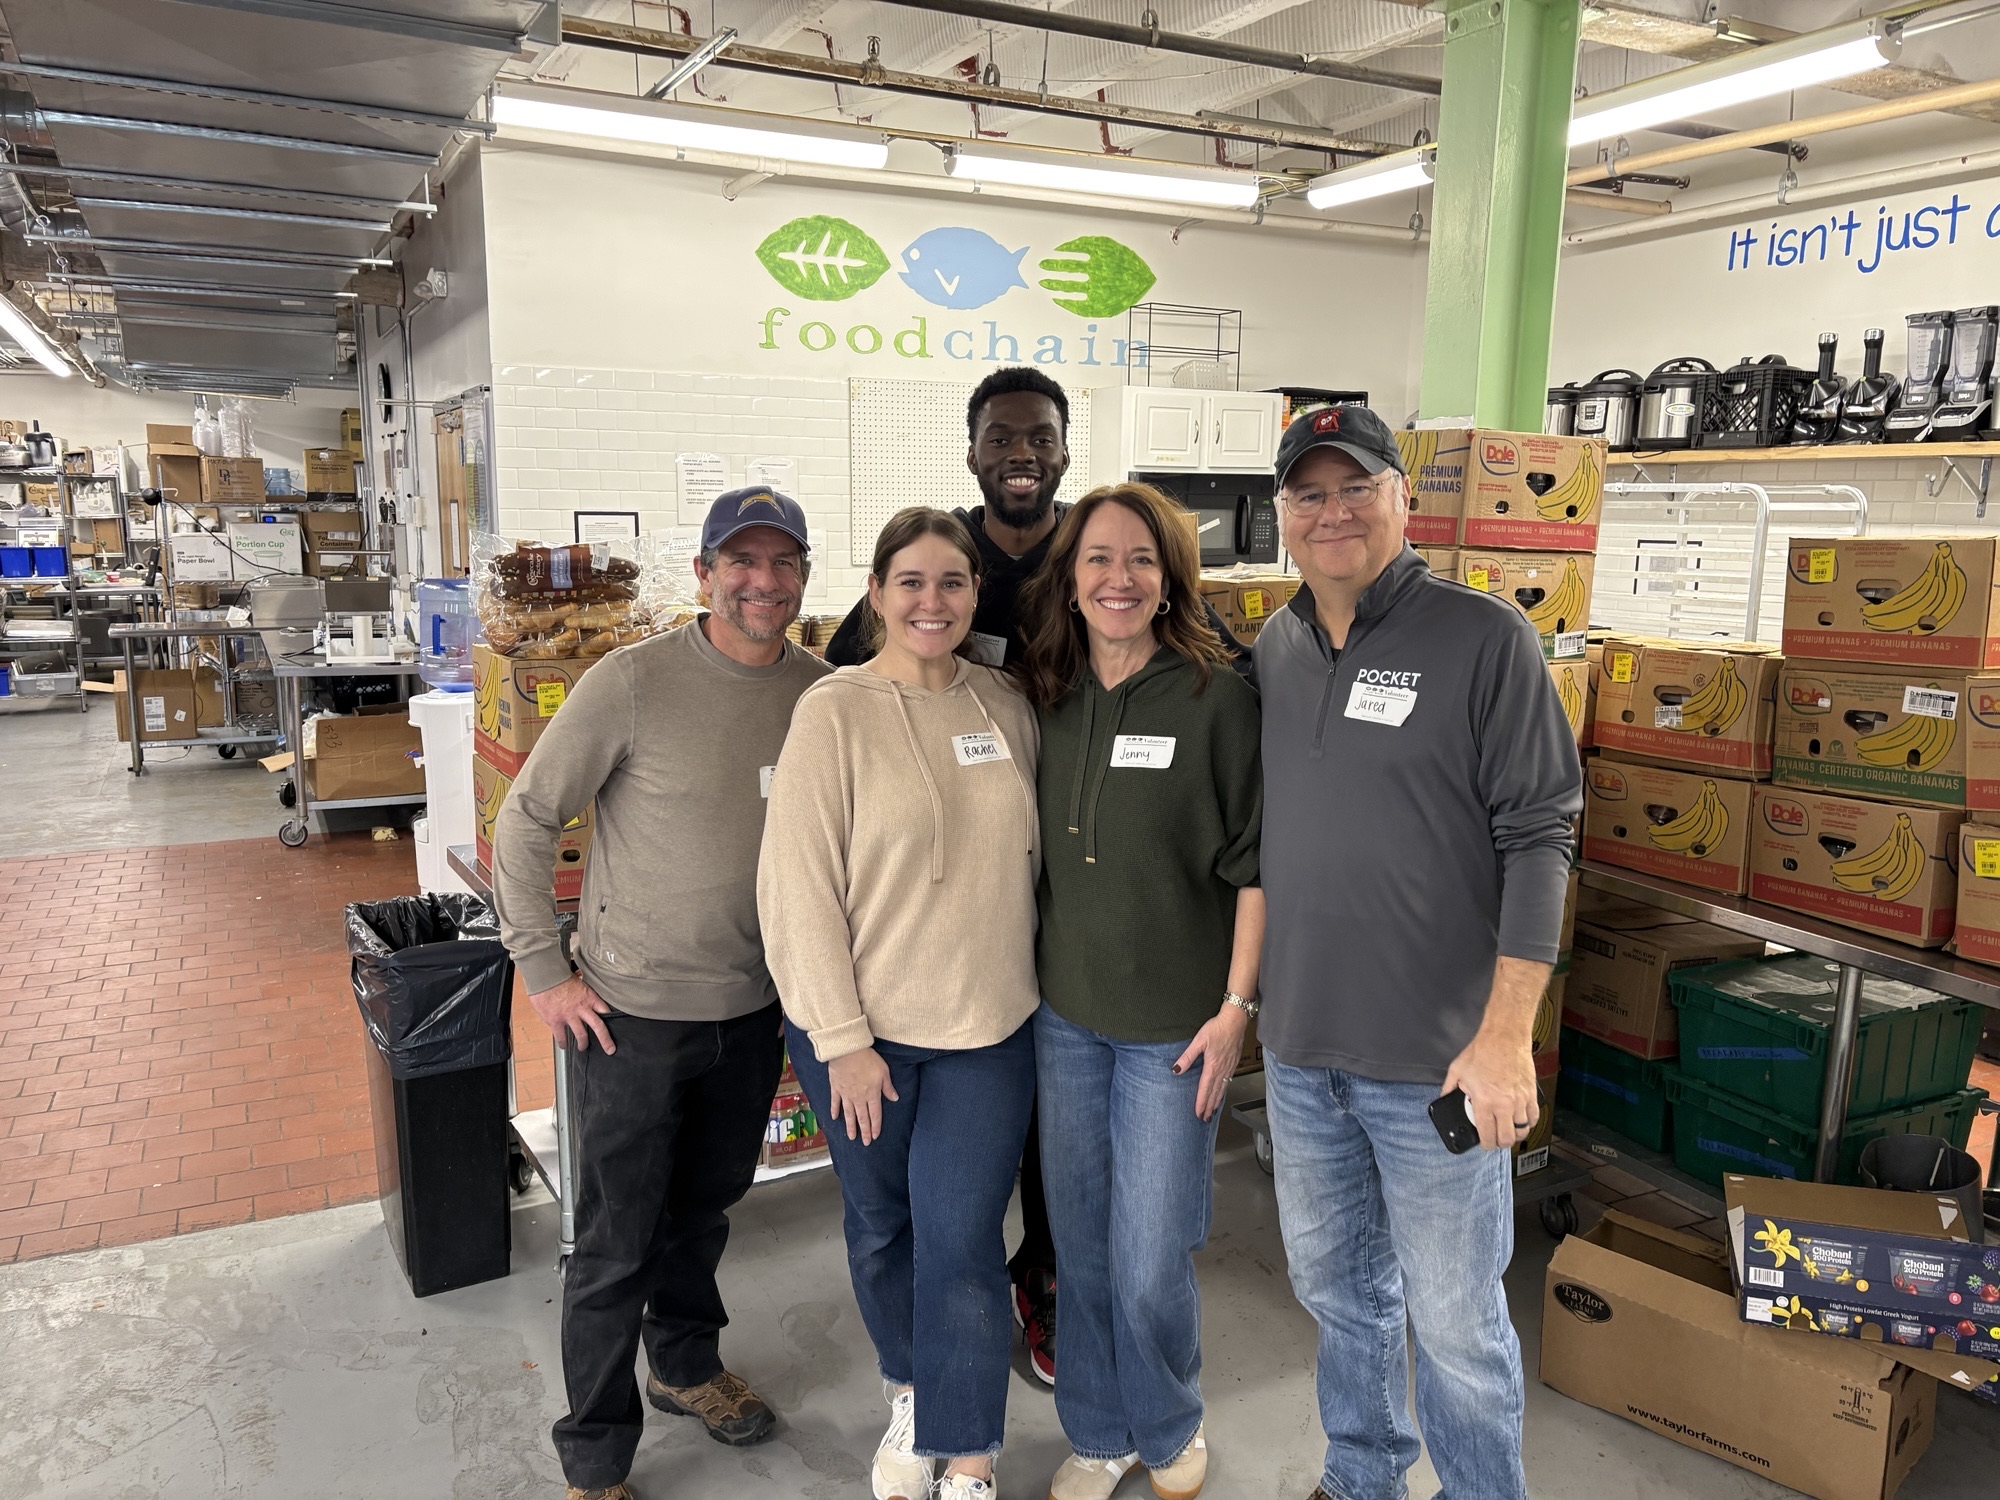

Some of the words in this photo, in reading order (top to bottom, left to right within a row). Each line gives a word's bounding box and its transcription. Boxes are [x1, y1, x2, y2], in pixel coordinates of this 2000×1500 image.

[1727, 227, 1759, 271] It
[1766, 209, 1863, 267] isn't
[1856, 193, 1972, 274] just
[757, 307, 1154, 368] foodchain
[1486, 444, 1515, 461] Dole
[1419, 465, 1462, 479] PREMIUM
[1417, 479, 1462, 493] BANANAS
[1408, 520, 1426, 529] EMIUM
[1426, 521, 1451, 530] BANANAS
[1507, 526, 1533, 534] BANANAS
[1539, 527, 1563, 536] PREMIUM
[1563, 528, 1585, 537] BANANAS
[267, 541, 285, 549] Cup
[527, 552, 538, 586] Cheesecake
[535, 553, 544, 580] Factory
[1792, 635, 1825, 645] PREMIUM
[1826, 636, 1860, 646] BANANAS
[1869, 639, 1908, 649] PREMIUM
[1909, 641, 1951, 651] BANANAS
[1356, 668, 1422, 687] POCKET
[1384, 689, 1409, 699] Volunteer
[1791, 687, 1825, 704] Dole
[1354, 696, 1386, 715] Jared
[1601, 726, 1626, 737] PREMIUM
[1626, 730, 1657, 742] BANANAS
[1664, 736, 1696, 748] PREMIUM
[1696, 740, 1730, 752] BANANAS
[963, 743, 999, 759] Rachel
[1119, 746, 1150, 762] Jenny
[1594, 772, 1623, 789] Dole
[1775, 758, 1815, 774] BANANAS
[1819, 764, 1864, 779] CERTIFIED
[1865, 769, 1908, 784] ORGANIC
[1909, 774, 1961, 791] BANANAS
[1771, 803, 1804, 822] Dole
[1619, 847, 1648, 860] BANANAS
[1654, 855, 1684, 869] PREMIUM
[1685, 860, 1717, 874] BANANAS
[556, 874, 581, 886] EMIUM
[1767, 881, 1797, 895] PREMIUM
[1797, 887, 1828, 901] BANANAS
[1836, 896, 1869, 911] PREMIUM
[1869, 903, 1904, 918] BANANAS
[768, 1118, 794, 1143] if
[1812, 1246, 1852, 1260] Chobani
[1827, 1256, 1852, 1265] Protein
[1903, 1258, 1944, 1273] Chobani
[1919, 1268, 1944, 1278] Protein
[1562, 1284, 1605, 1311] Taylor
[1570, 1300, 1595, 1316] FARMS
[1829, 1302, 1843, 1311] High
[1843, 1305, 1864, 1313] Protein
[1864, 1307, 1882, 1316] Lowfat
[1883, 1310, 1900, 1318] Greek
[1900, 1313, 1920, 1321] Yogurt
[1626, 1403, 1770, 1468] www.taylorfarms.com
